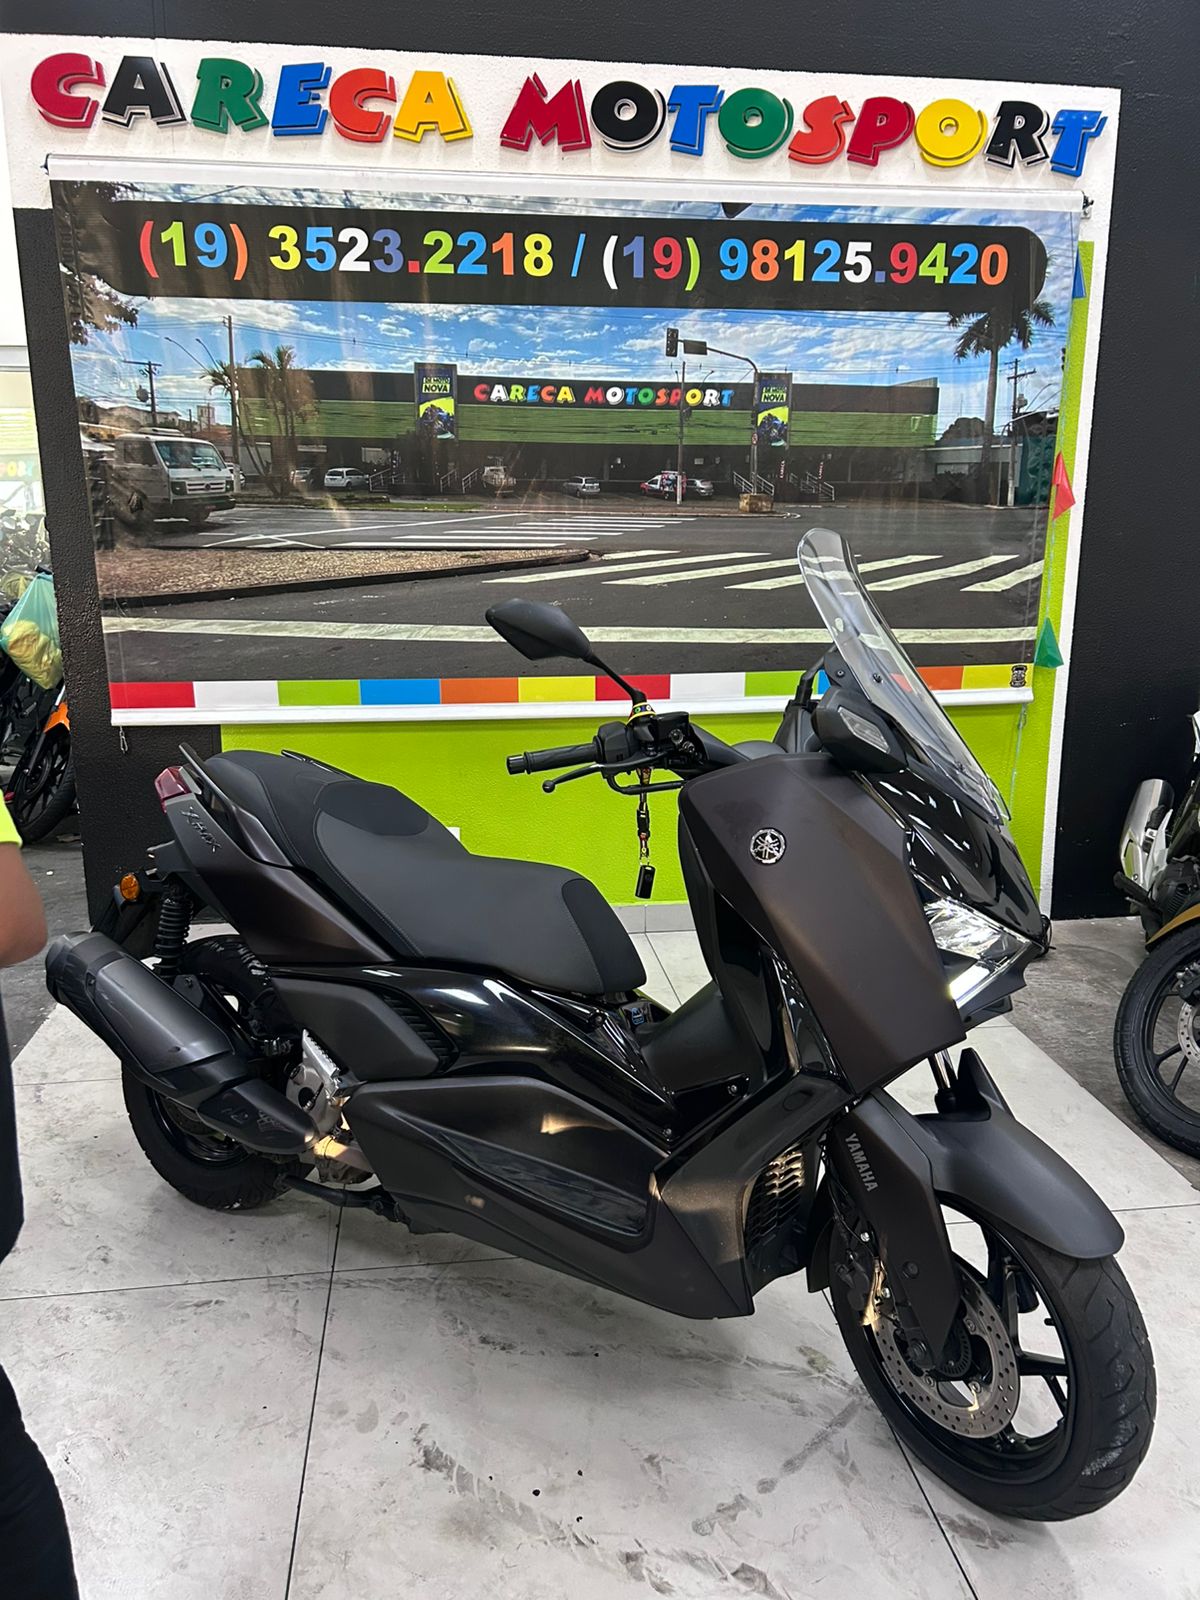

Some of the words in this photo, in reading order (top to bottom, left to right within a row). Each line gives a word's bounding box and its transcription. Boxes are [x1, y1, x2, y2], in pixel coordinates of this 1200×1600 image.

[30, 52, 473, 143] CARECA
[500, 72, 1107, 178] MOTOSPORT
[139, 221, 248, 281] (19)
[268, 225, 553, 277] 3523.2218
[571, 234, 585, 277] /
[603, 235, 699, 291] (19)
[719, 238, 1008, 285] 98125.9420
[424, 384, 449, 392] NOVA
[474, 383, 576, 404] CARECA
[584, 386, 734, 407] MOTOSPORT
[763, 393, 785, 401] NOVA
[845, 1133, 878, 1192] YAMAHA
